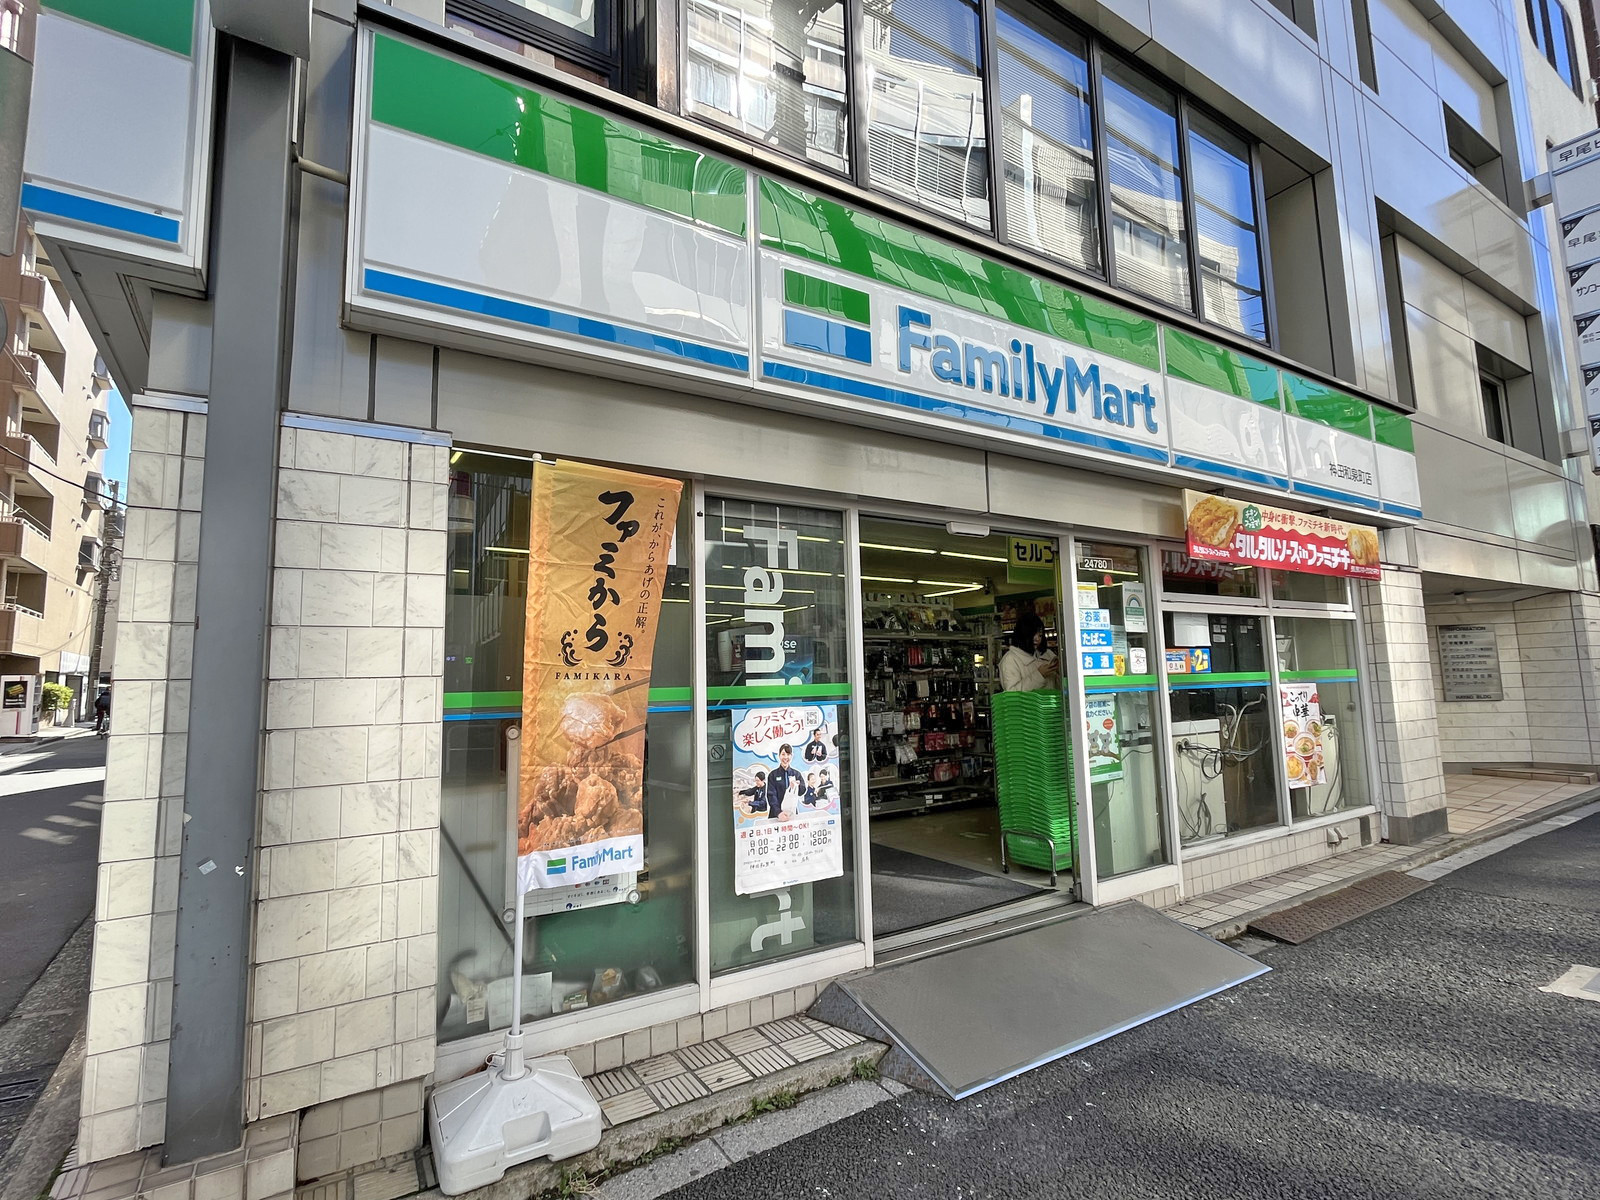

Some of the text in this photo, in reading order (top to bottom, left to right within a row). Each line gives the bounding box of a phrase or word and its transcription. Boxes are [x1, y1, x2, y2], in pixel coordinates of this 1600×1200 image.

[897, 304, 1158, 434] FamilyMart
[1235, 532, 1351, 570] タルタルソースinファミチキ
[584, 490, 640, 652] ファミから
[1084, 558, 1108, 569] 24780
[1082, 631, 1108, 646] たばこ
[555, 672, 632, 681] FAMIKARA
[753, 708, 795, 729] ファミマで
[742, 719, 805, 747] 楽しく働こう!
